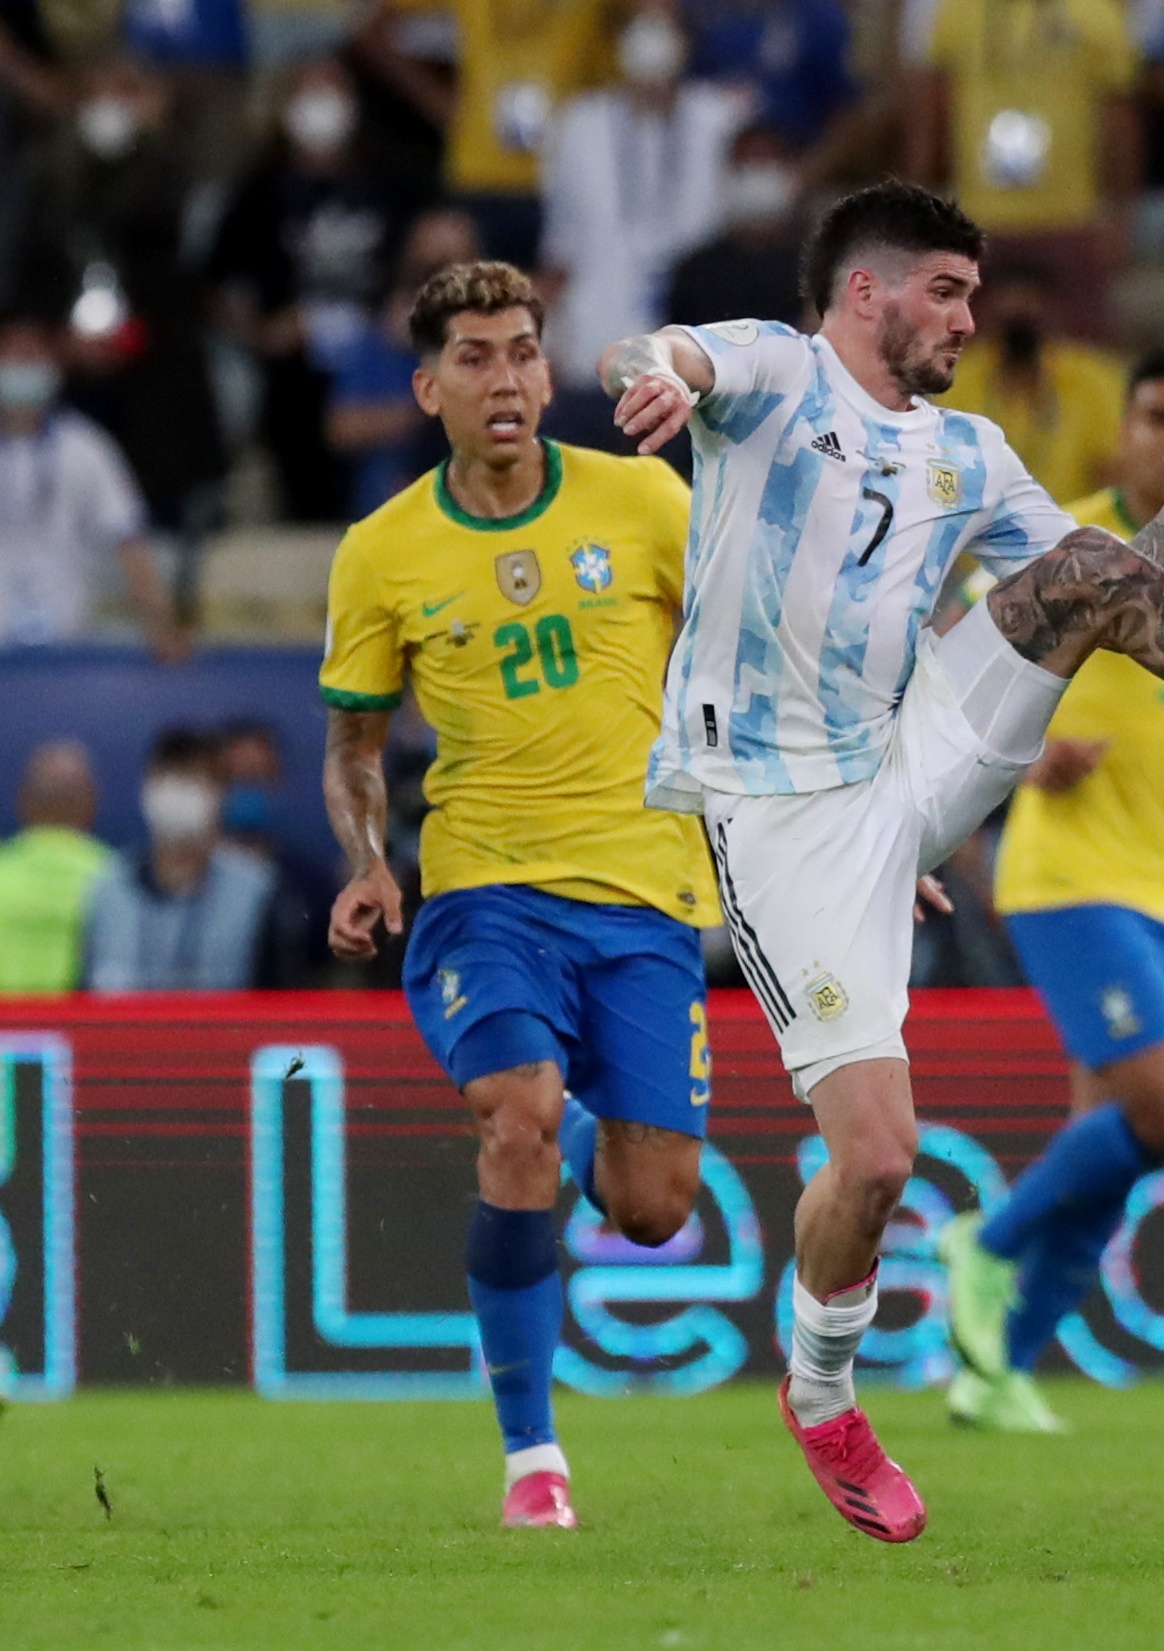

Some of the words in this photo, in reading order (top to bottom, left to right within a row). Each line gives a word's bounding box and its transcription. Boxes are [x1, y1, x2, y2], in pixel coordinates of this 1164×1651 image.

[810, 440, 847, 462] adidas
[857, 486, 894, 567] 7
[493, 614, 581, 700] 20
